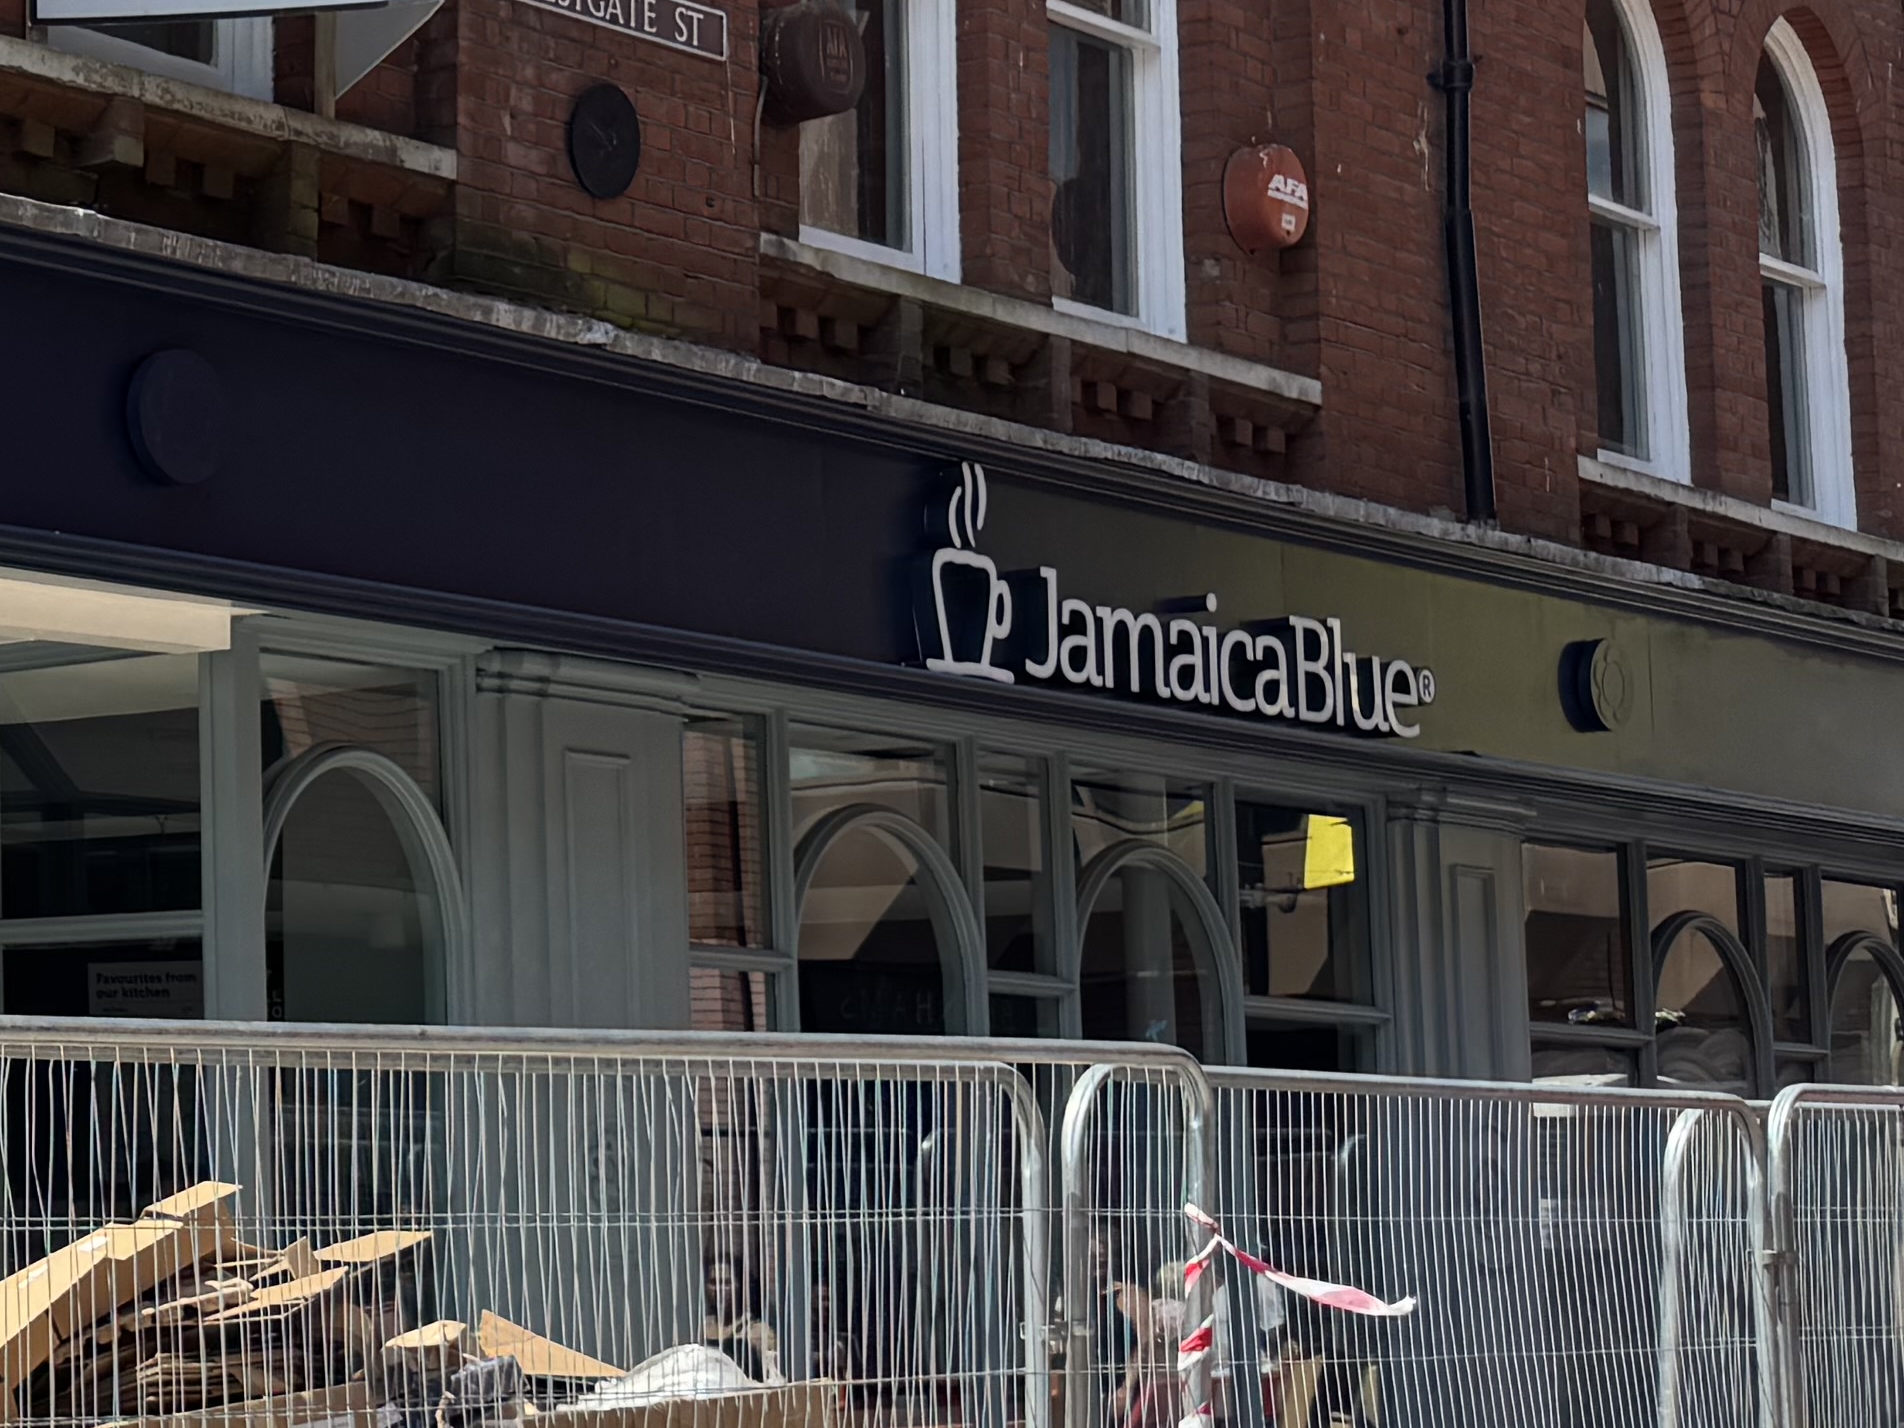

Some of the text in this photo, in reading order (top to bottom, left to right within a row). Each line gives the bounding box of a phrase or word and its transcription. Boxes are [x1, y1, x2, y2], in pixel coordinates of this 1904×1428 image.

[673, 7, 704, 47] ST
[1268, 173, 1309, 204] AFA
[95, 971, 196, 986] Favourites from
[121, 985, 171, 1000] kitchen
